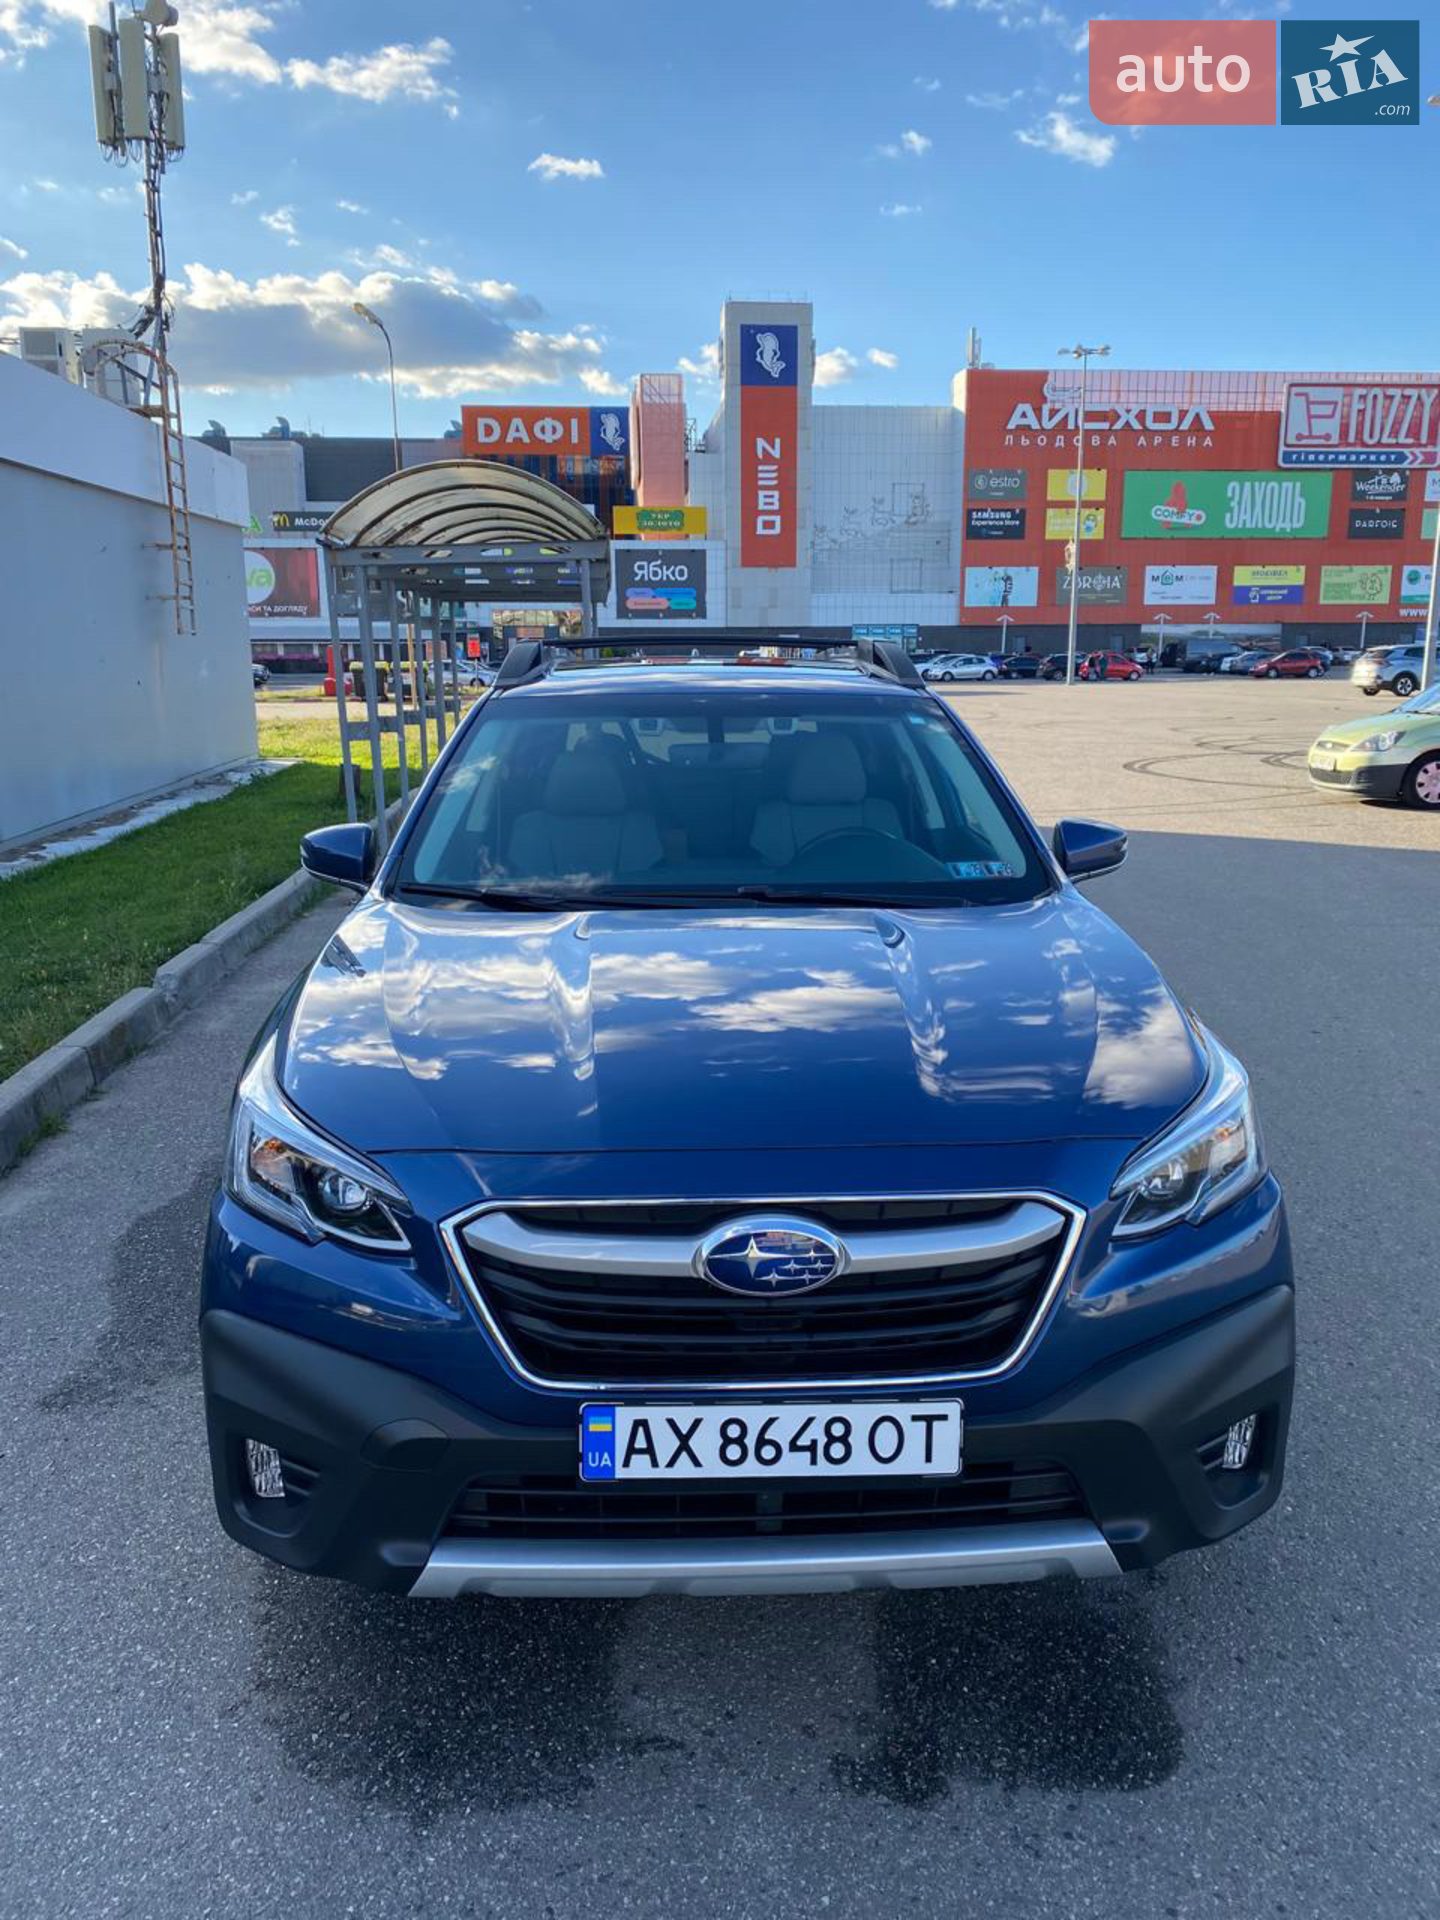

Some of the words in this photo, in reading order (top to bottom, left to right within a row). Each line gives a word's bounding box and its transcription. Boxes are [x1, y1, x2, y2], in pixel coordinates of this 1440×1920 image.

[1347, 387, 1438, 445] FOZZY
[1004, 435, 1118, 447] ЛЬОДОВА
[1137, 435, 1214, 447] АРЕНА
[1292, 452, 1397, 462] гіпермаркет
[989, 476, 1020, 488] estro
[1355, 478, 1406, 493] Weekender
[1224, 481, 1306, 532] ЗАХОДЬ
[294, 517, 326, 527] McDo
[971, 511, 1012, 519] SAMSUNG
[1153, 507, 1195, 522] COMFY
[971, 519, 1003, 527] Experience
[634, 560, 688, 581] Ябко
[622, 1417, 704, 1469] AX
[719, 1416, 853, 1468] 8648
[867, 1413, 949, 1465] OT
[588, 1451, 613, 1468] UA
